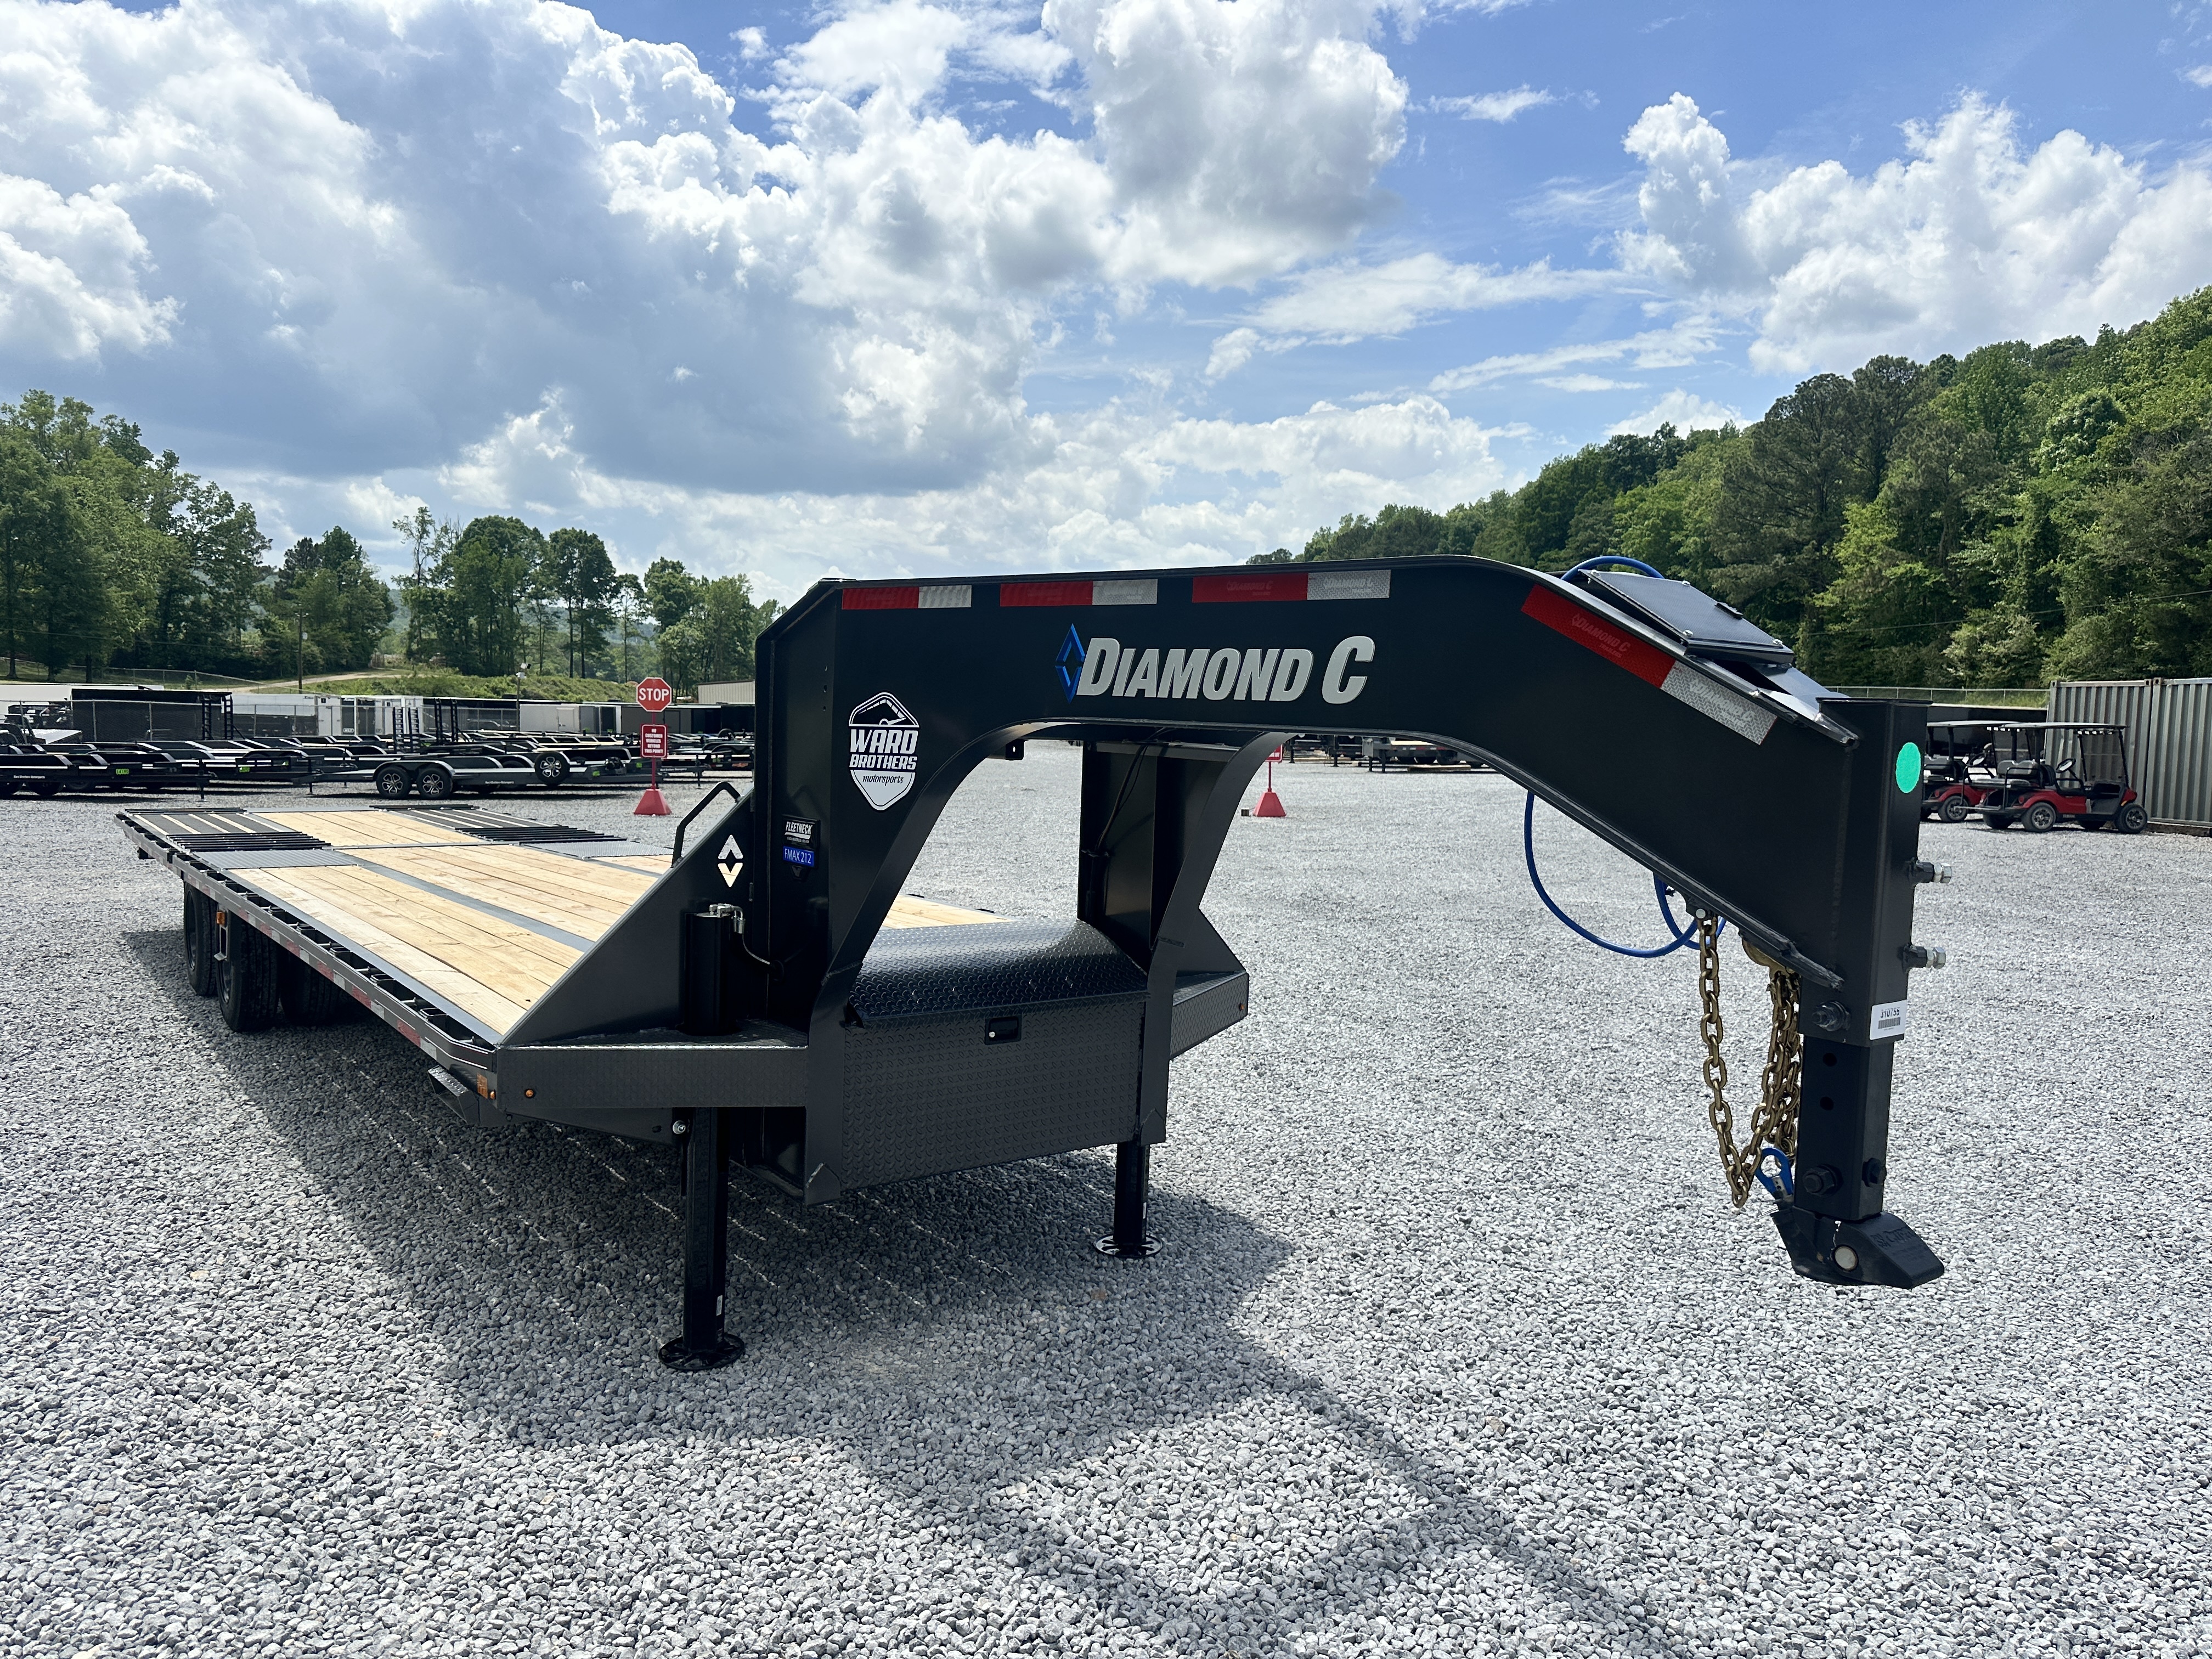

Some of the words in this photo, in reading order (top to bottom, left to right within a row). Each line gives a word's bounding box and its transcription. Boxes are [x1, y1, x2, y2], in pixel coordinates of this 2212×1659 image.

[1575, 617, 1620, 647] DIAMOND
[1618, 641, 1631, 652] C
[1076, 637, 1314, 702] DIAMOND
[1322, 635, 1375, 704] C
[639, 688, 669, 701] STOP
[850, 729, 918, 754] WARD
[849, 754, 917, 770] BROTHERS
[862, 774, 904, 786] motorsports
[785, 821, 812, 834] FLEETNECK
[785, 848, 800, 862] FMAX
[800, 851, 811, 864] 212
